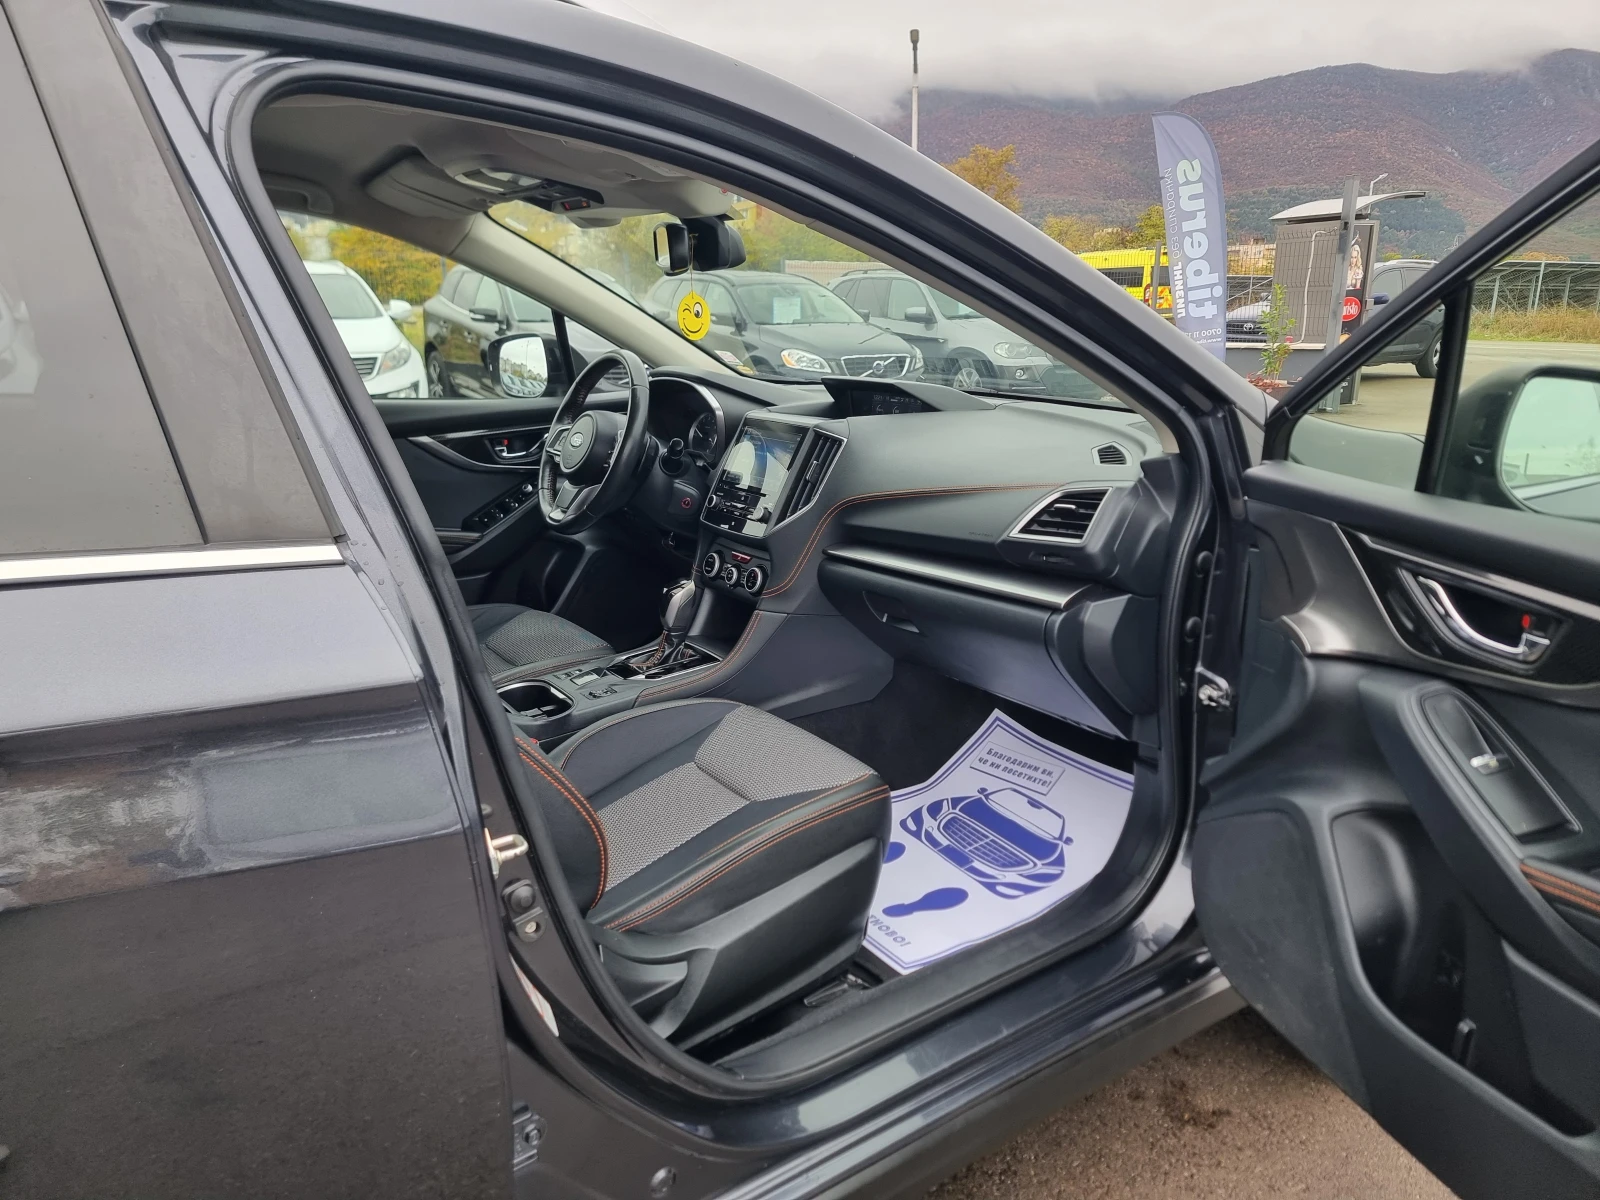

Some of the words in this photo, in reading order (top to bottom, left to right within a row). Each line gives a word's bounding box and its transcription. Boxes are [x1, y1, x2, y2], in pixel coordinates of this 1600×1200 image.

[978, 756, 989, 766] че
[989, 761, 1002, 770] ни
[1001, 765, 1053, 788] посетихте!
[986, 747, 1041, 773] Благодарим
[1040, 768, 1054, 779] ви,
[869, 914, 912, 947] ТНОВО!
